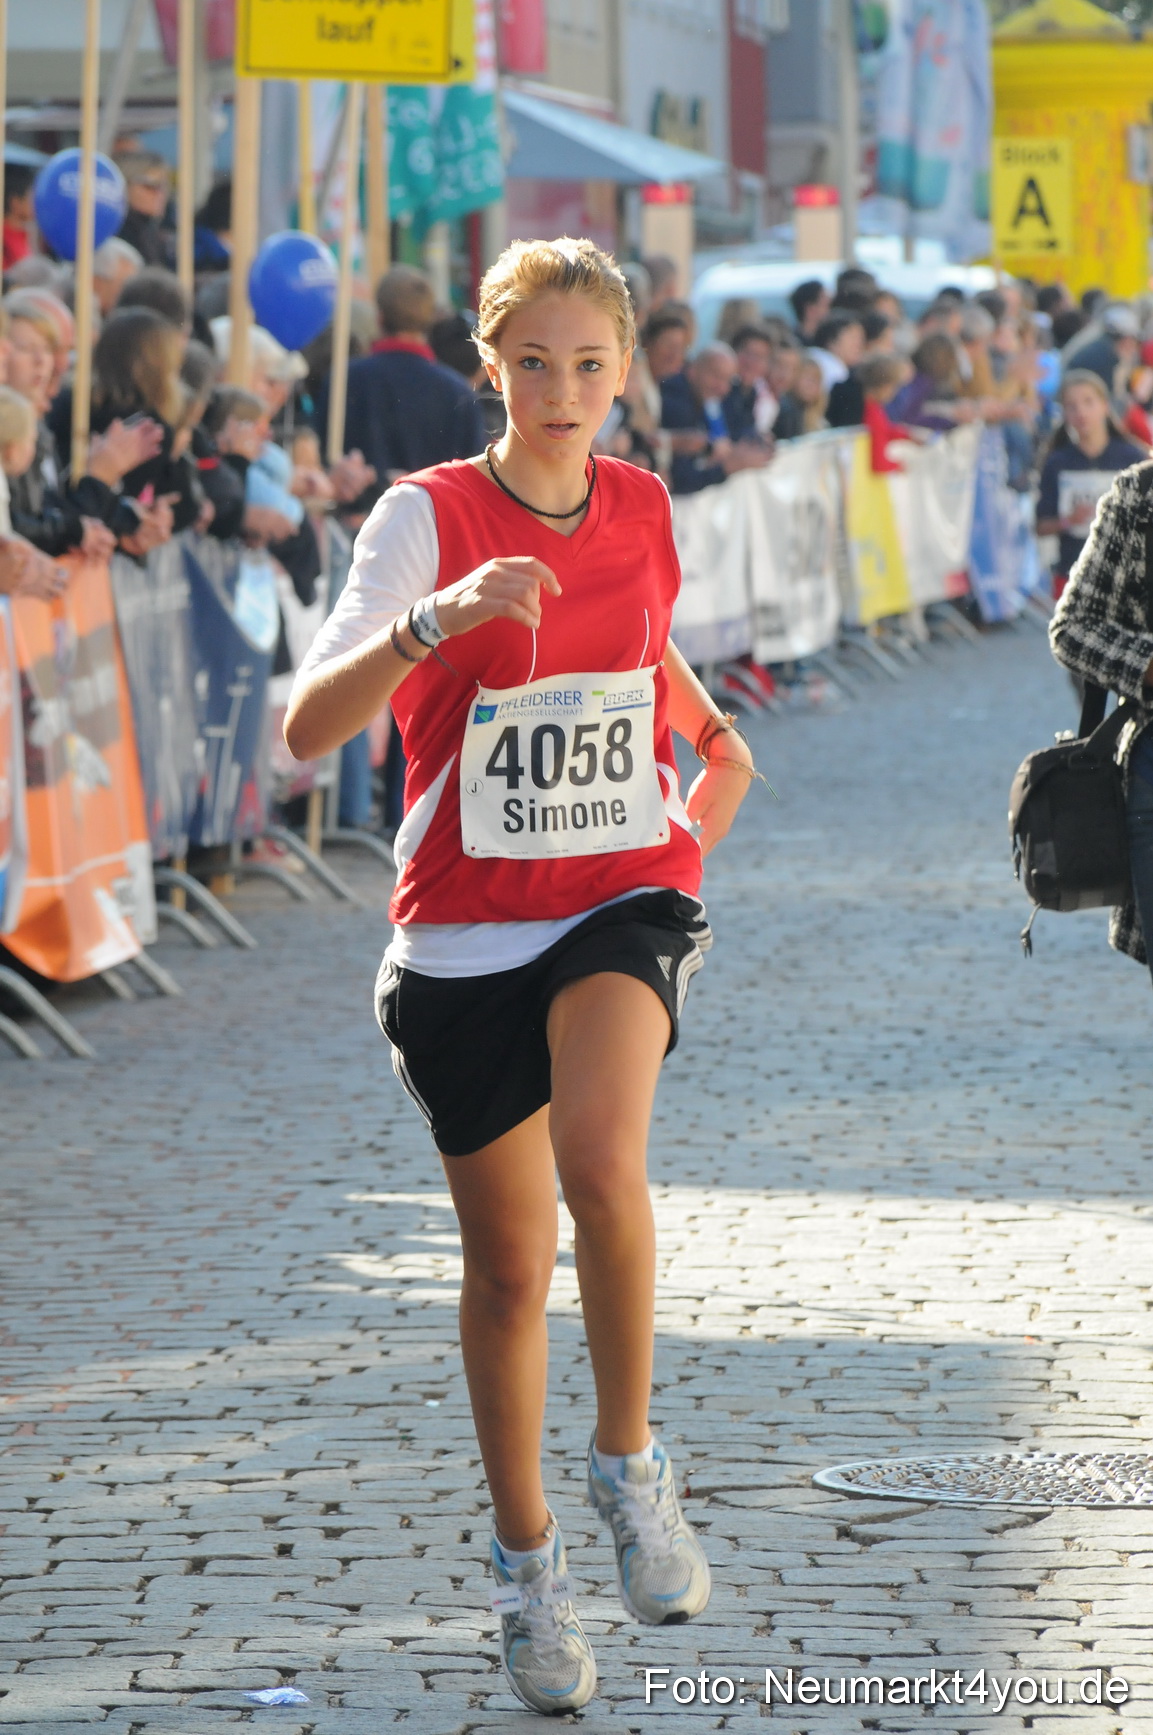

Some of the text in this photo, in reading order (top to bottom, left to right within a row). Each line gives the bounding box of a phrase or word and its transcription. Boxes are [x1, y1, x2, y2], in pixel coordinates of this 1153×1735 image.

[1010, 174, 1051, 229] A
[500, 690, 583, 711] PFLEIDERER
[485, 718, 633, 790] 4058
[503, 798, 627, 834] Simone
